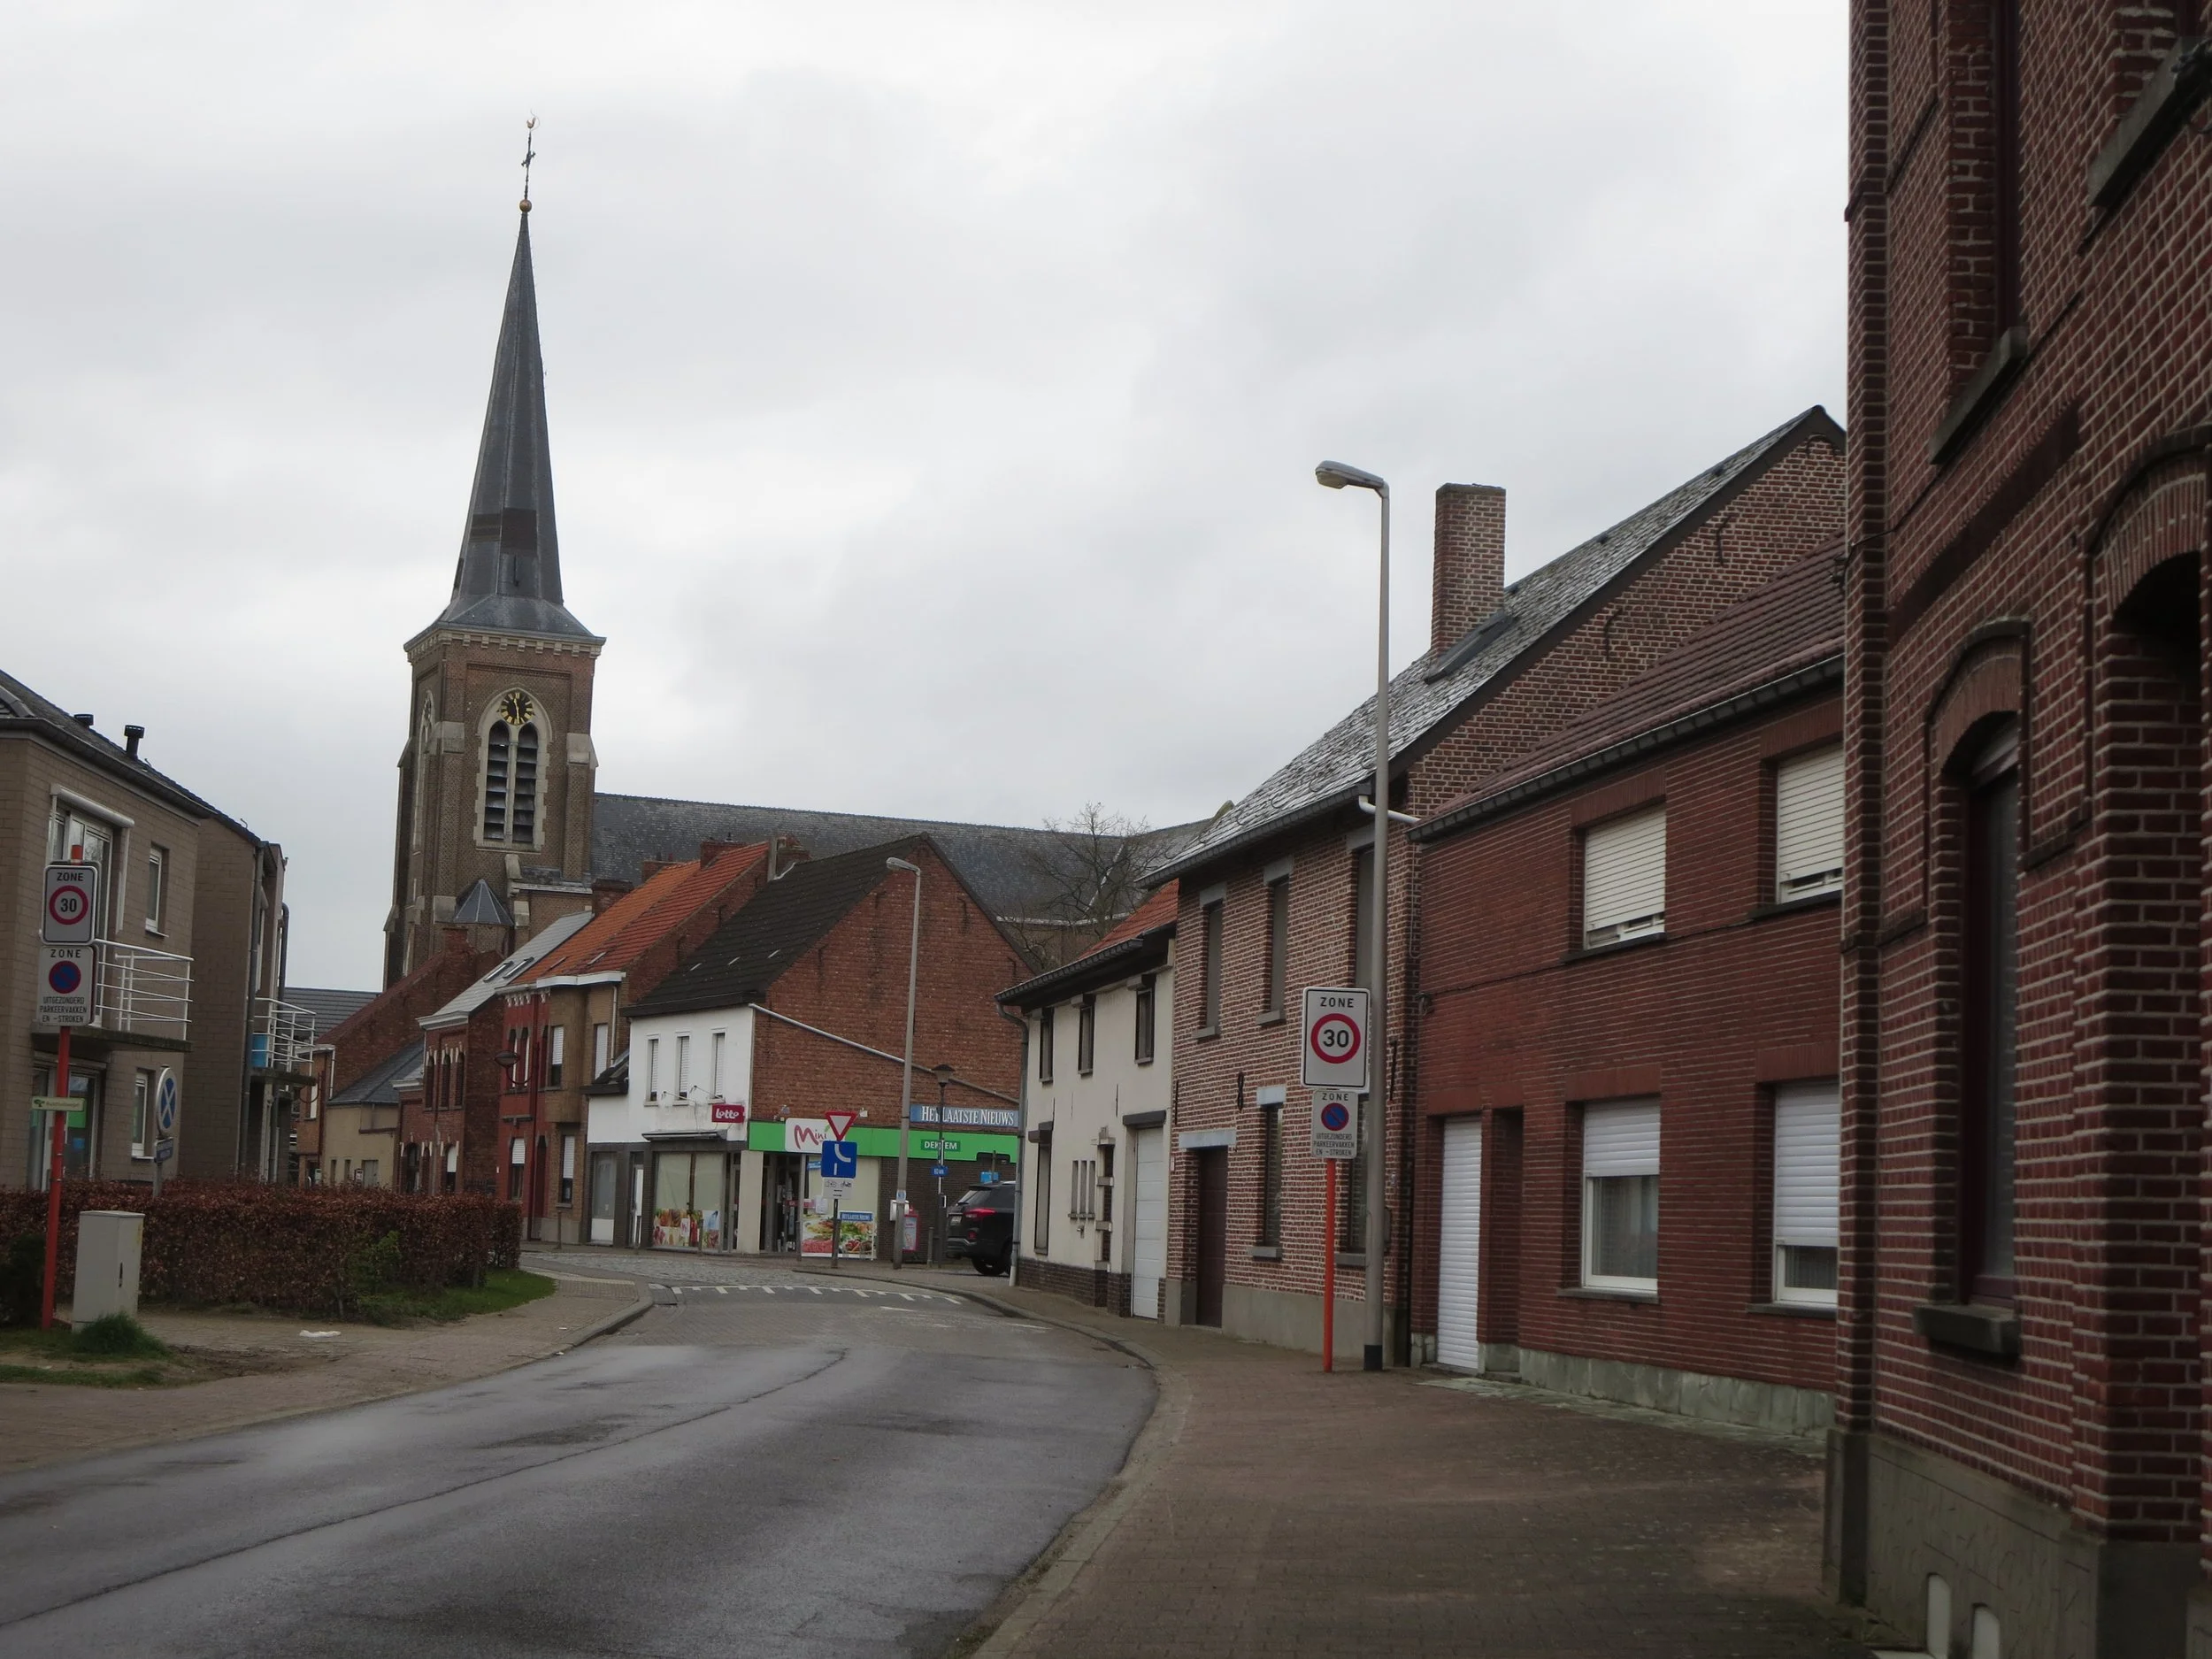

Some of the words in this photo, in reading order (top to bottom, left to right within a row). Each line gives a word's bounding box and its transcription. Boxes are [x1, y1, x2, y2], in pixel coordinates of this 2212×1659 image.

[57, 872, 84, 882] ZONE
[60, 898, 77, 912] 30
[50, 949, 81, 958] ZONE
[1320, 996, 1354, 1008] ZONE
[40, 1005, 87, 1014] PARKEERVAKKEN
[1323, 1029, 1349, 1048] 30
[1322, 1093, 1349, 1102] ZONE
[716, 1108, 740, 1119] Lotto
[942, 1106, 979, 1125] LAATSTE
[980, 1109, 1015, 1125] NIEUWS
[794, 1125, 827, 1150] Mini
